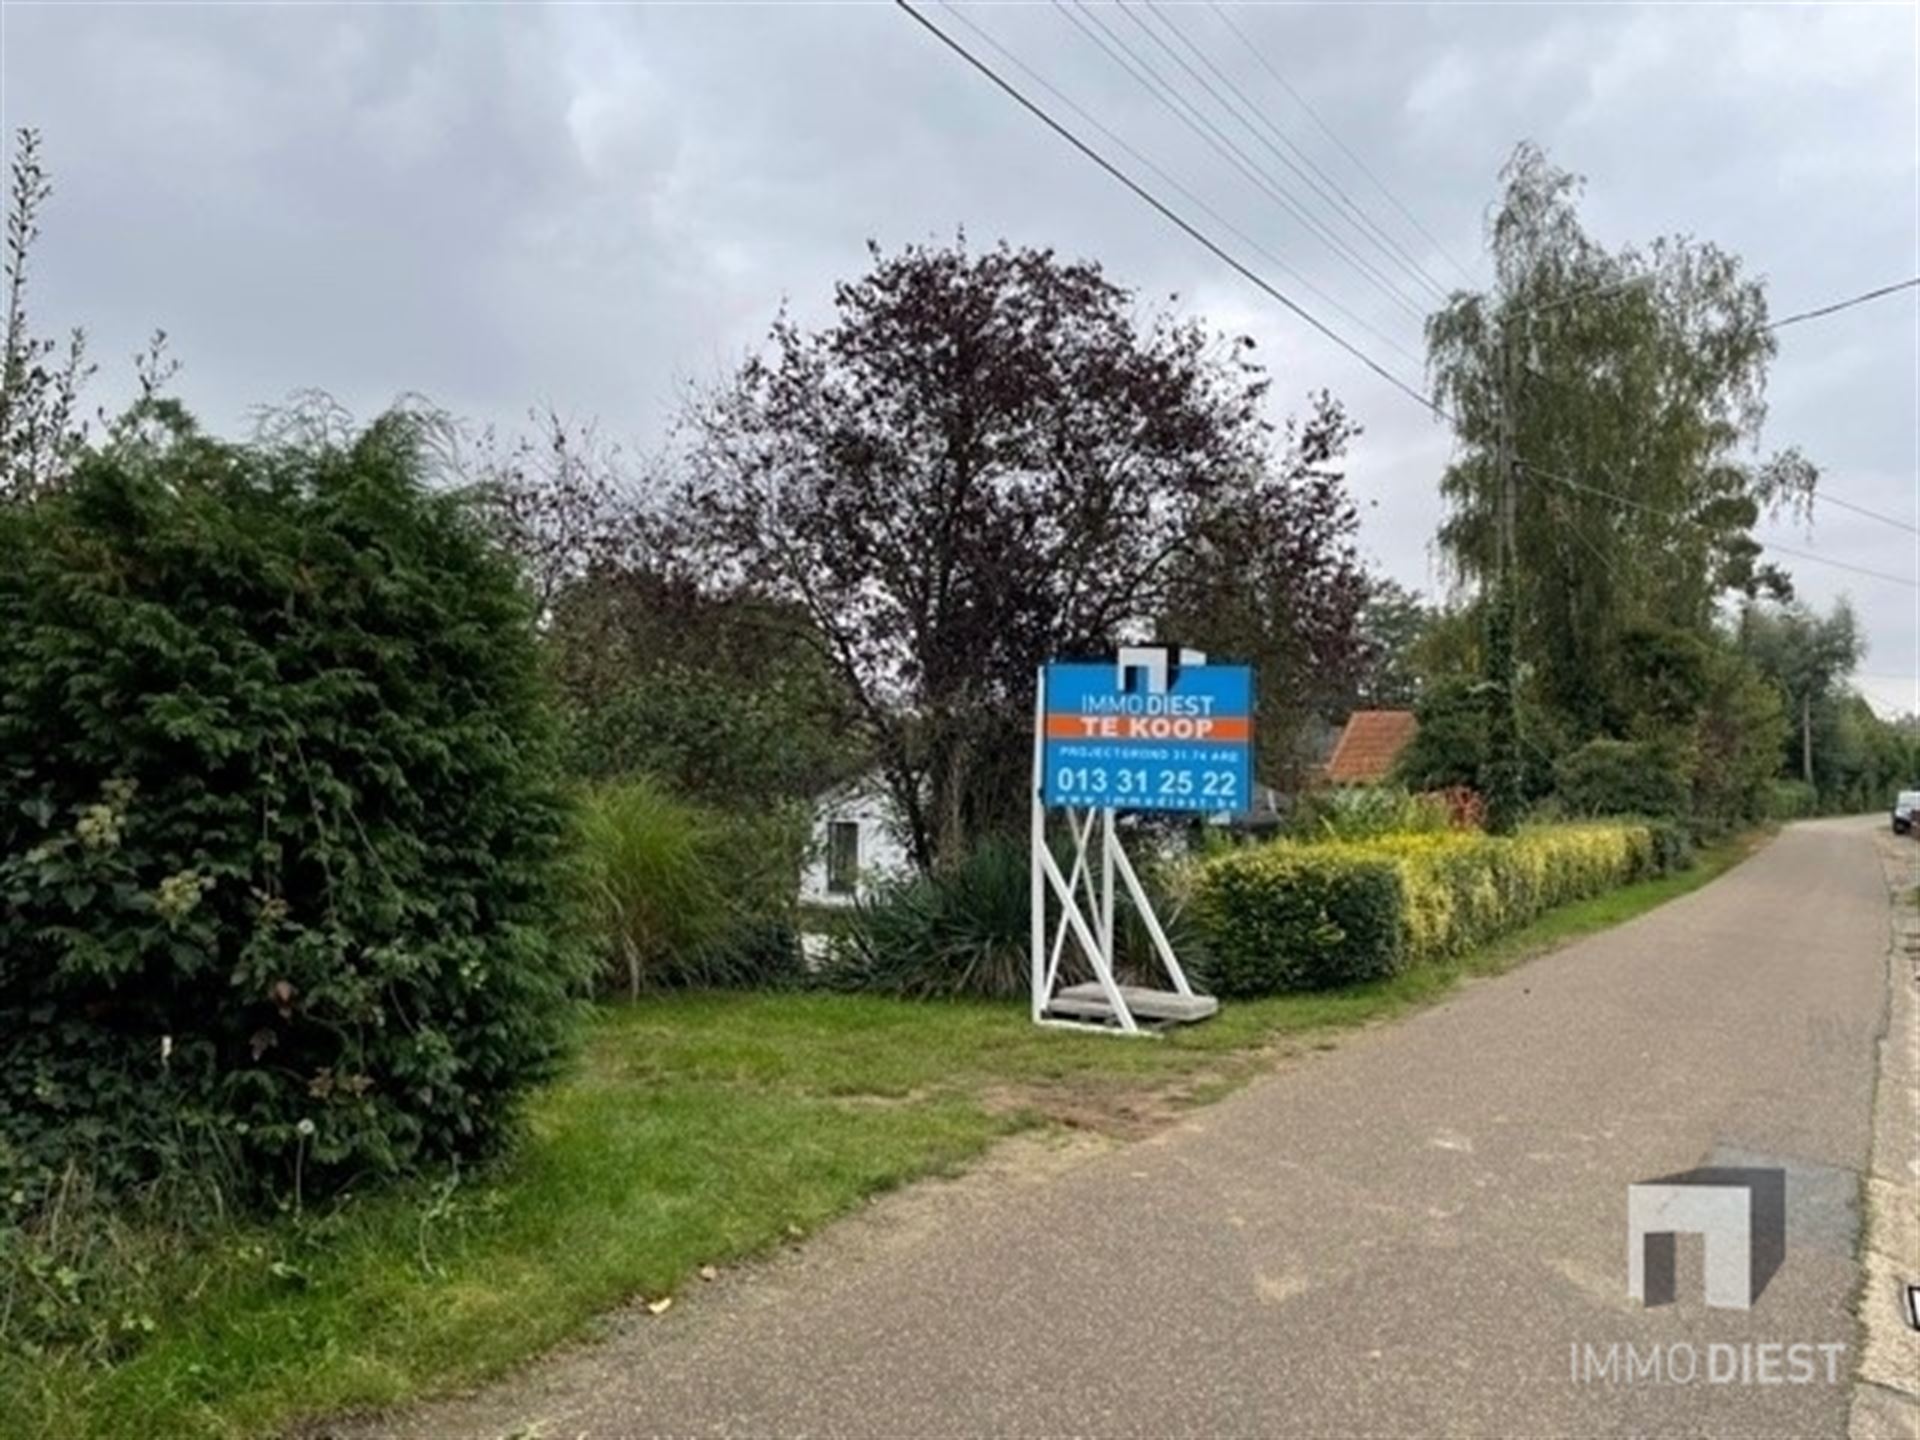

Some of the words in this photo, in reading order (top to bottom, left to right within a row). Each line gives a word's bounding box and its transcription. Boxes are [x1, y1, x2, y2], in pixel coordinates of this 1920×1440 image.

[1081, 694, 1142, 714] IMMO
[1147, 695, 1214, 715] DIEST
[1081, 717, 1118, 737] TE
[1129, 719, 1213, 739] KOOP
[1057, 767, 1107, 791] 013
[1117, 769, 1148, 793] 31
[1159, 770, 1193, 795] 25
[1202, 771, 1236, 796] 22
